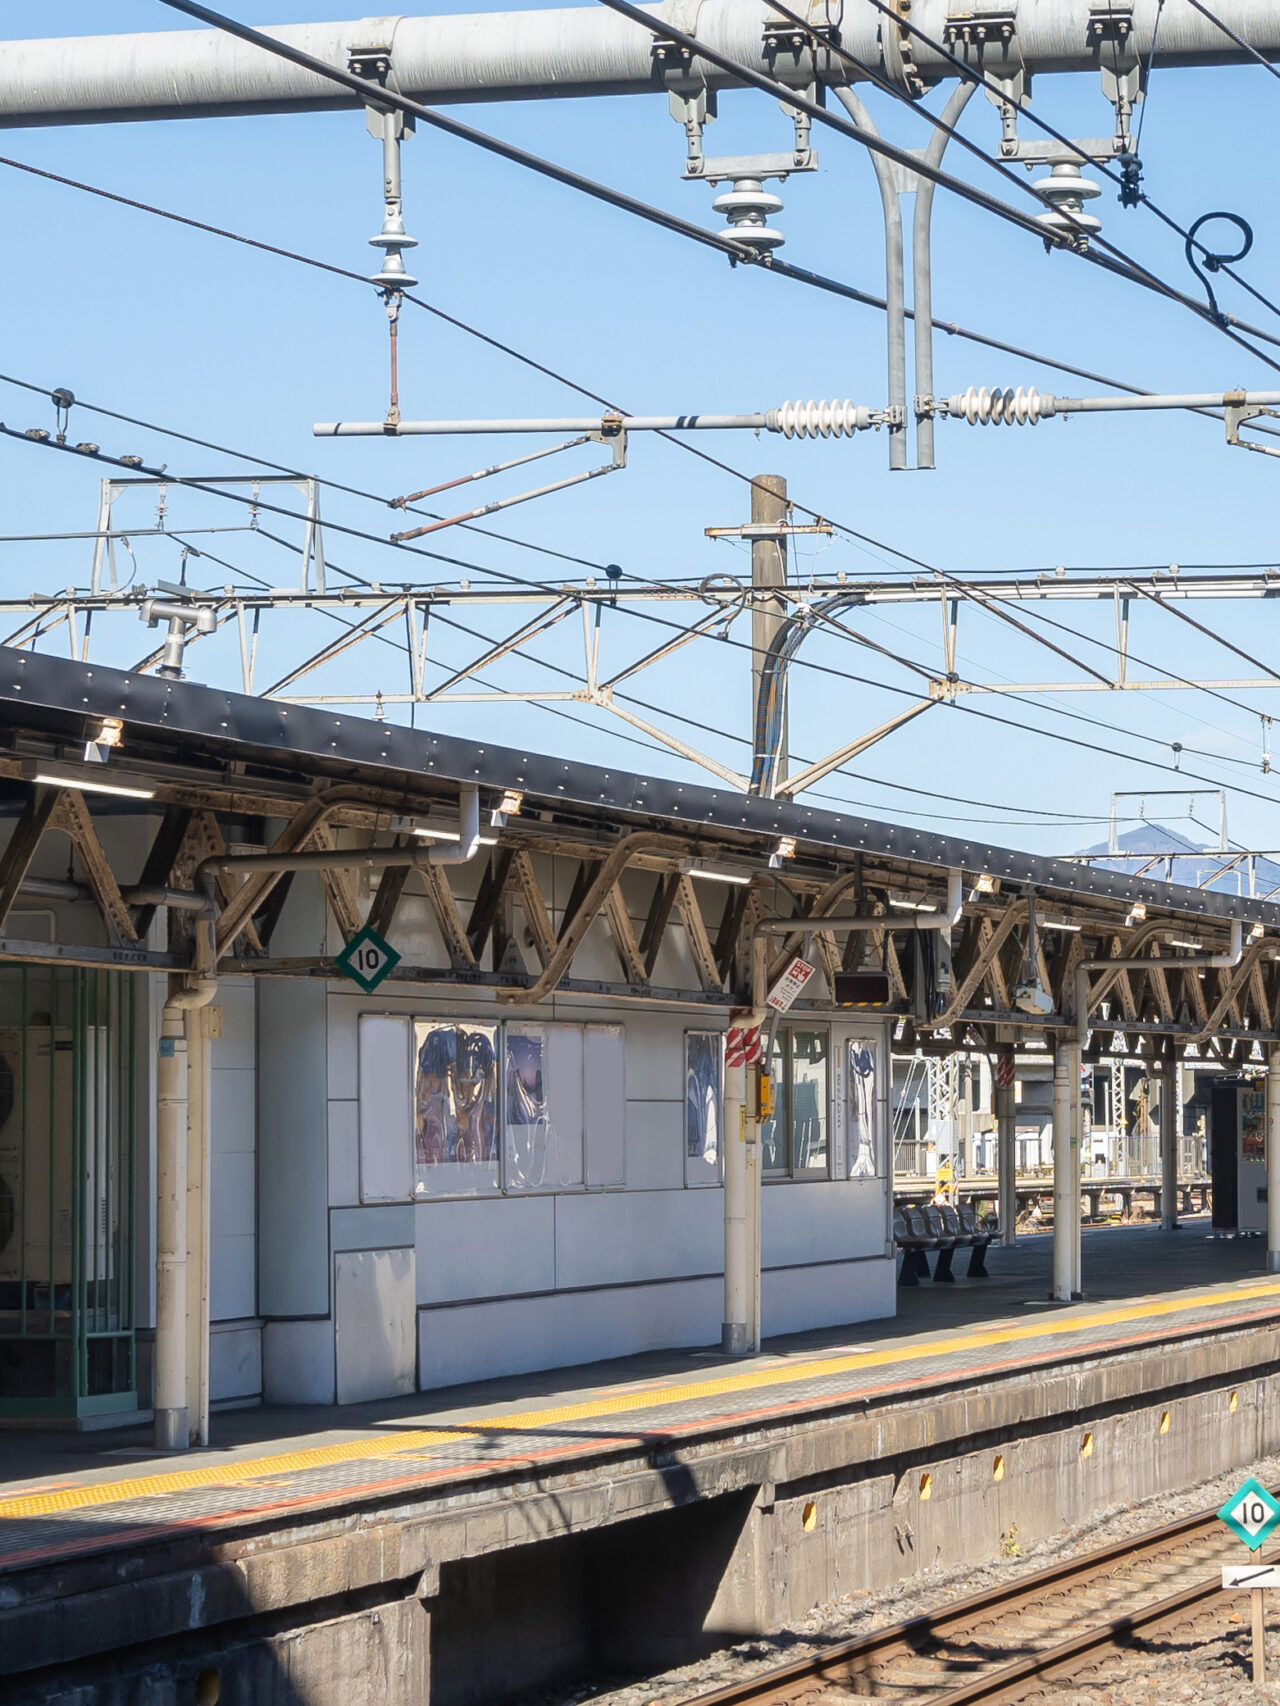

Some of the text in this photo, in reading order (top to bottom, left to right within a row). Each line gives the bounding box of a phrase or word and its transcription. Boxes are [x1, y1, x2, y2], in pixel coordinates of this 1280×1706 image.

[358, 948, 380, 970] 10
[796, 961, 812, 973] STOP
[1243, 1502, 1264, 1524] 10
